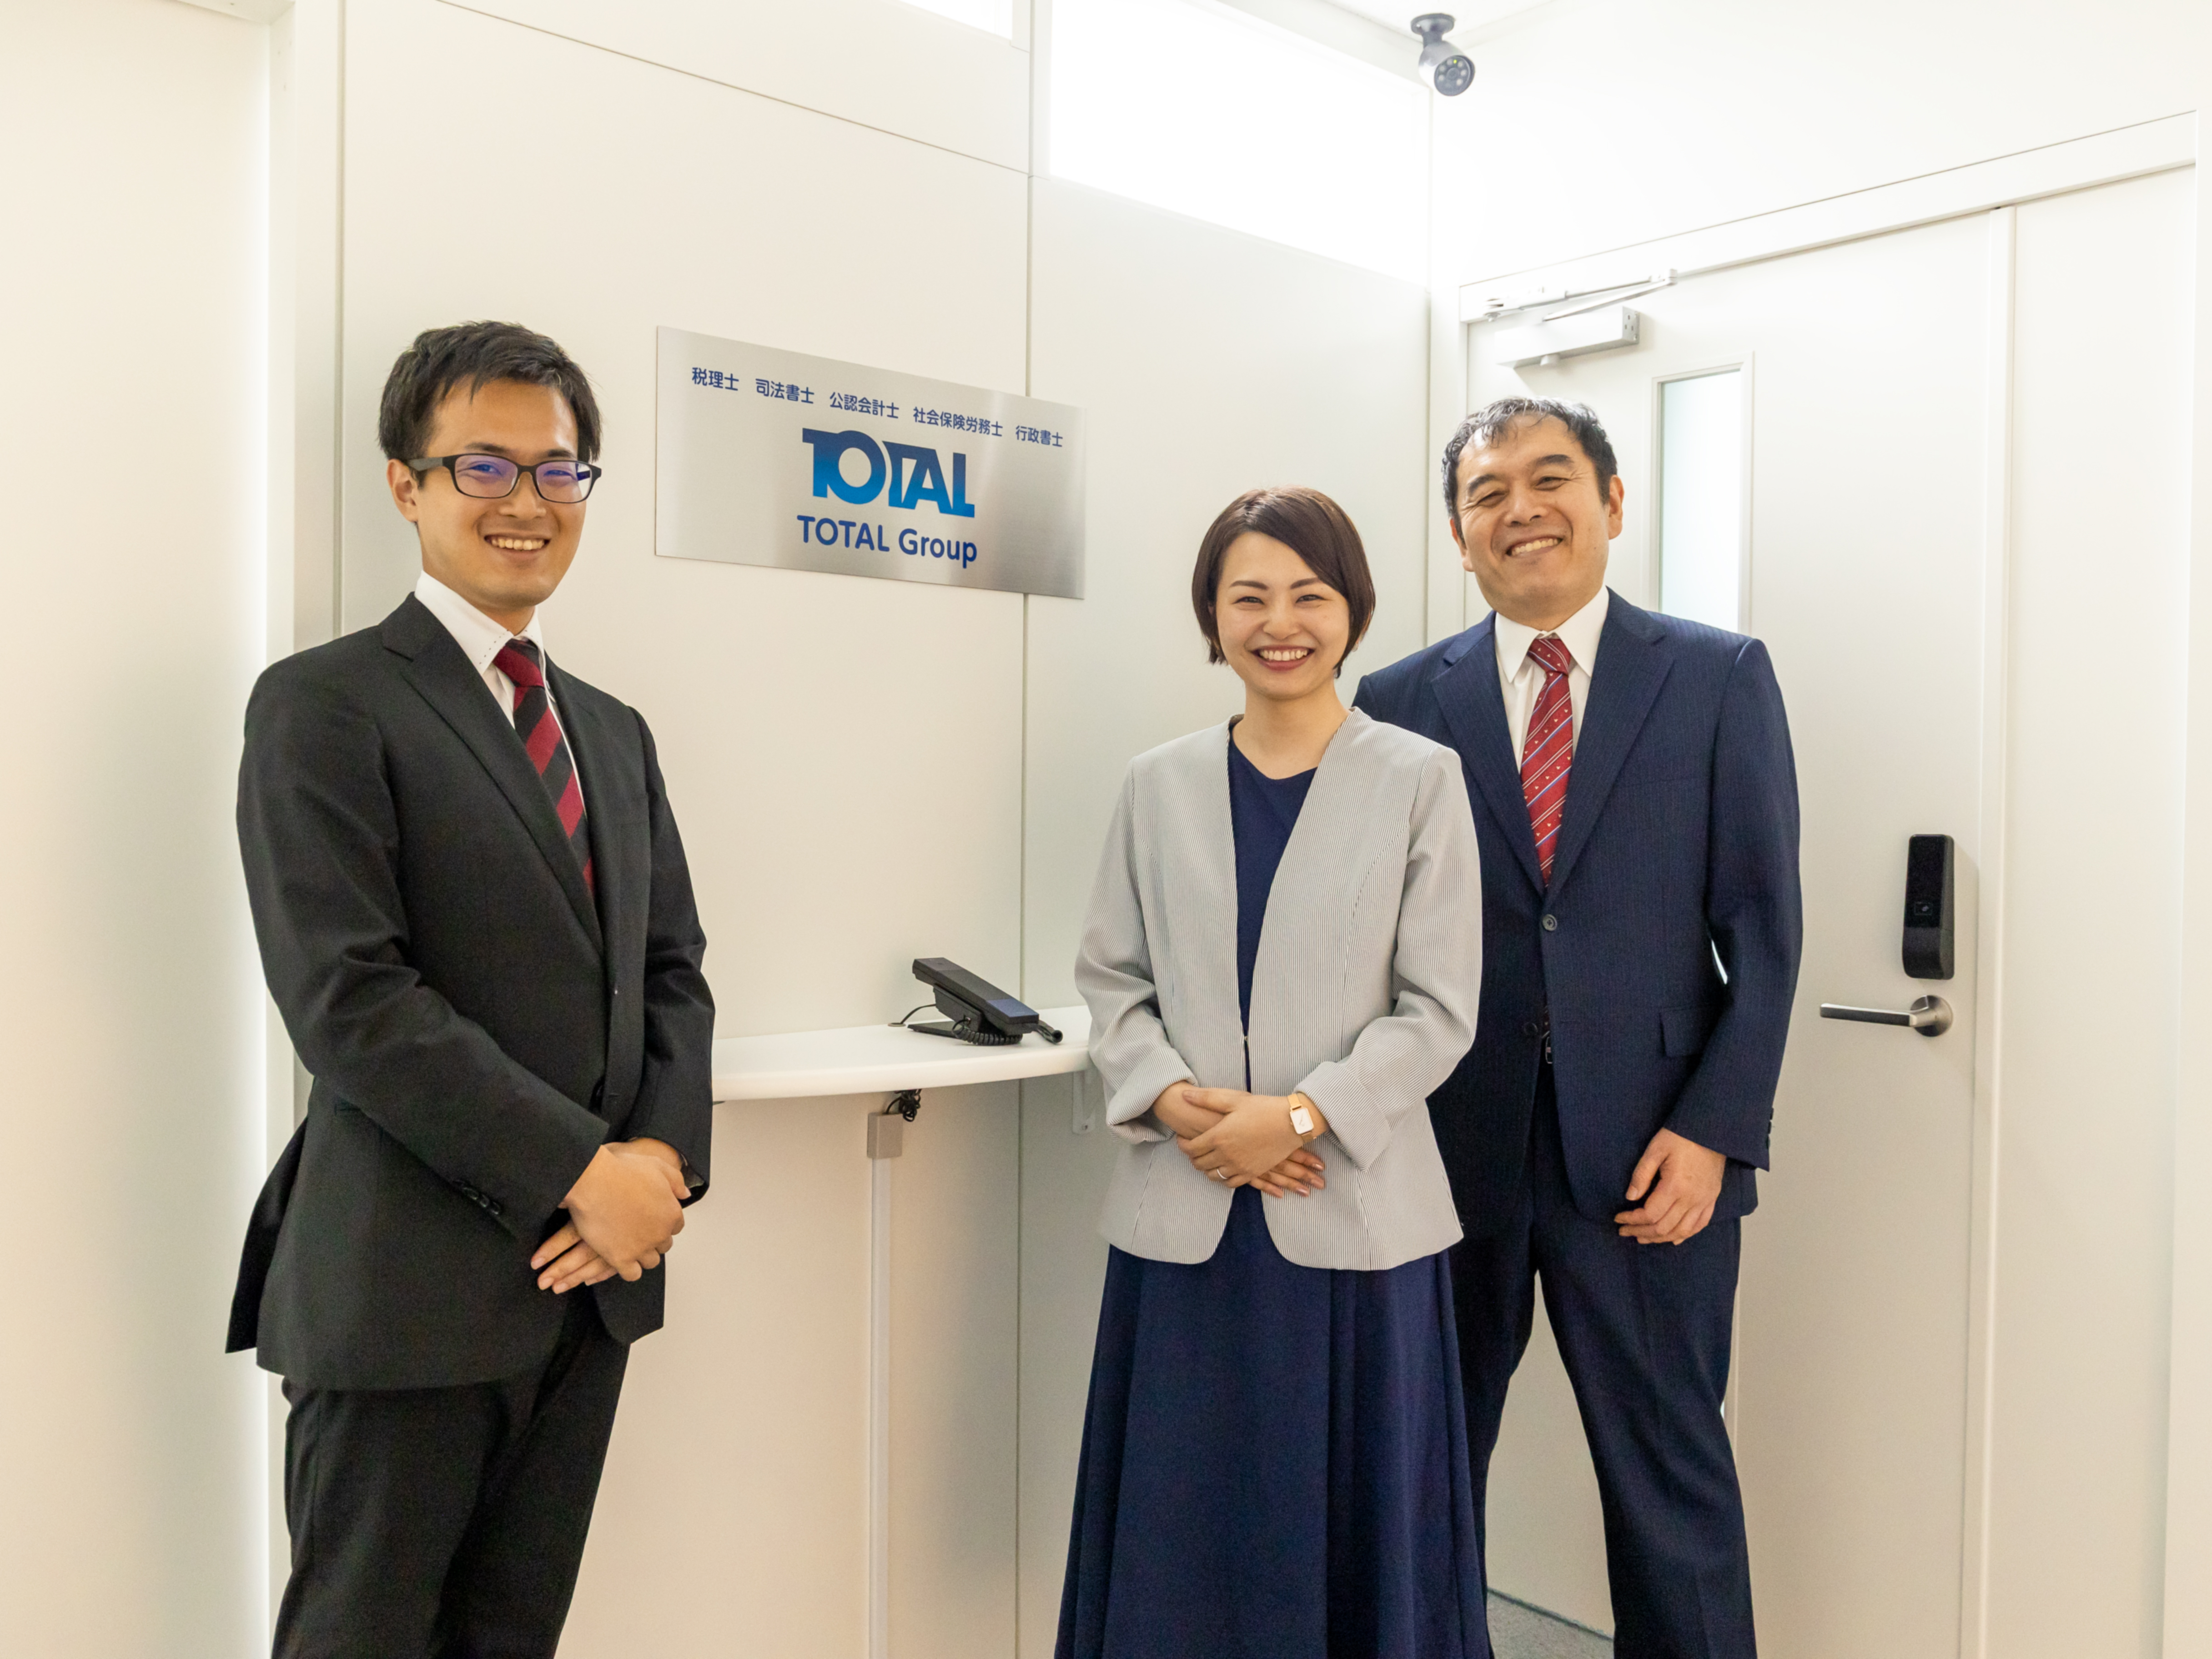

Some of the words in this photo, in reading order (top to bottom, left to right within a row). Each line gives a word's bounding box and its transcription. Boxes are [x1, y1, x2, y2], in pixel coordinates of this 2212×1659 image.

[692, 367, 739, 391] 税理士
[755, 378, 814, 404] 司法書士
[830, 392, 900, 419] 公認会計士
[913, 407, 1003, 437] 社会保険労務士
[1016, 425, 1063, 447] 行政書士
[802, 428, 975, 518] TOTAL
[797, 515, 890, 552] TOTAL
[899, 528, 977, 568] Group
